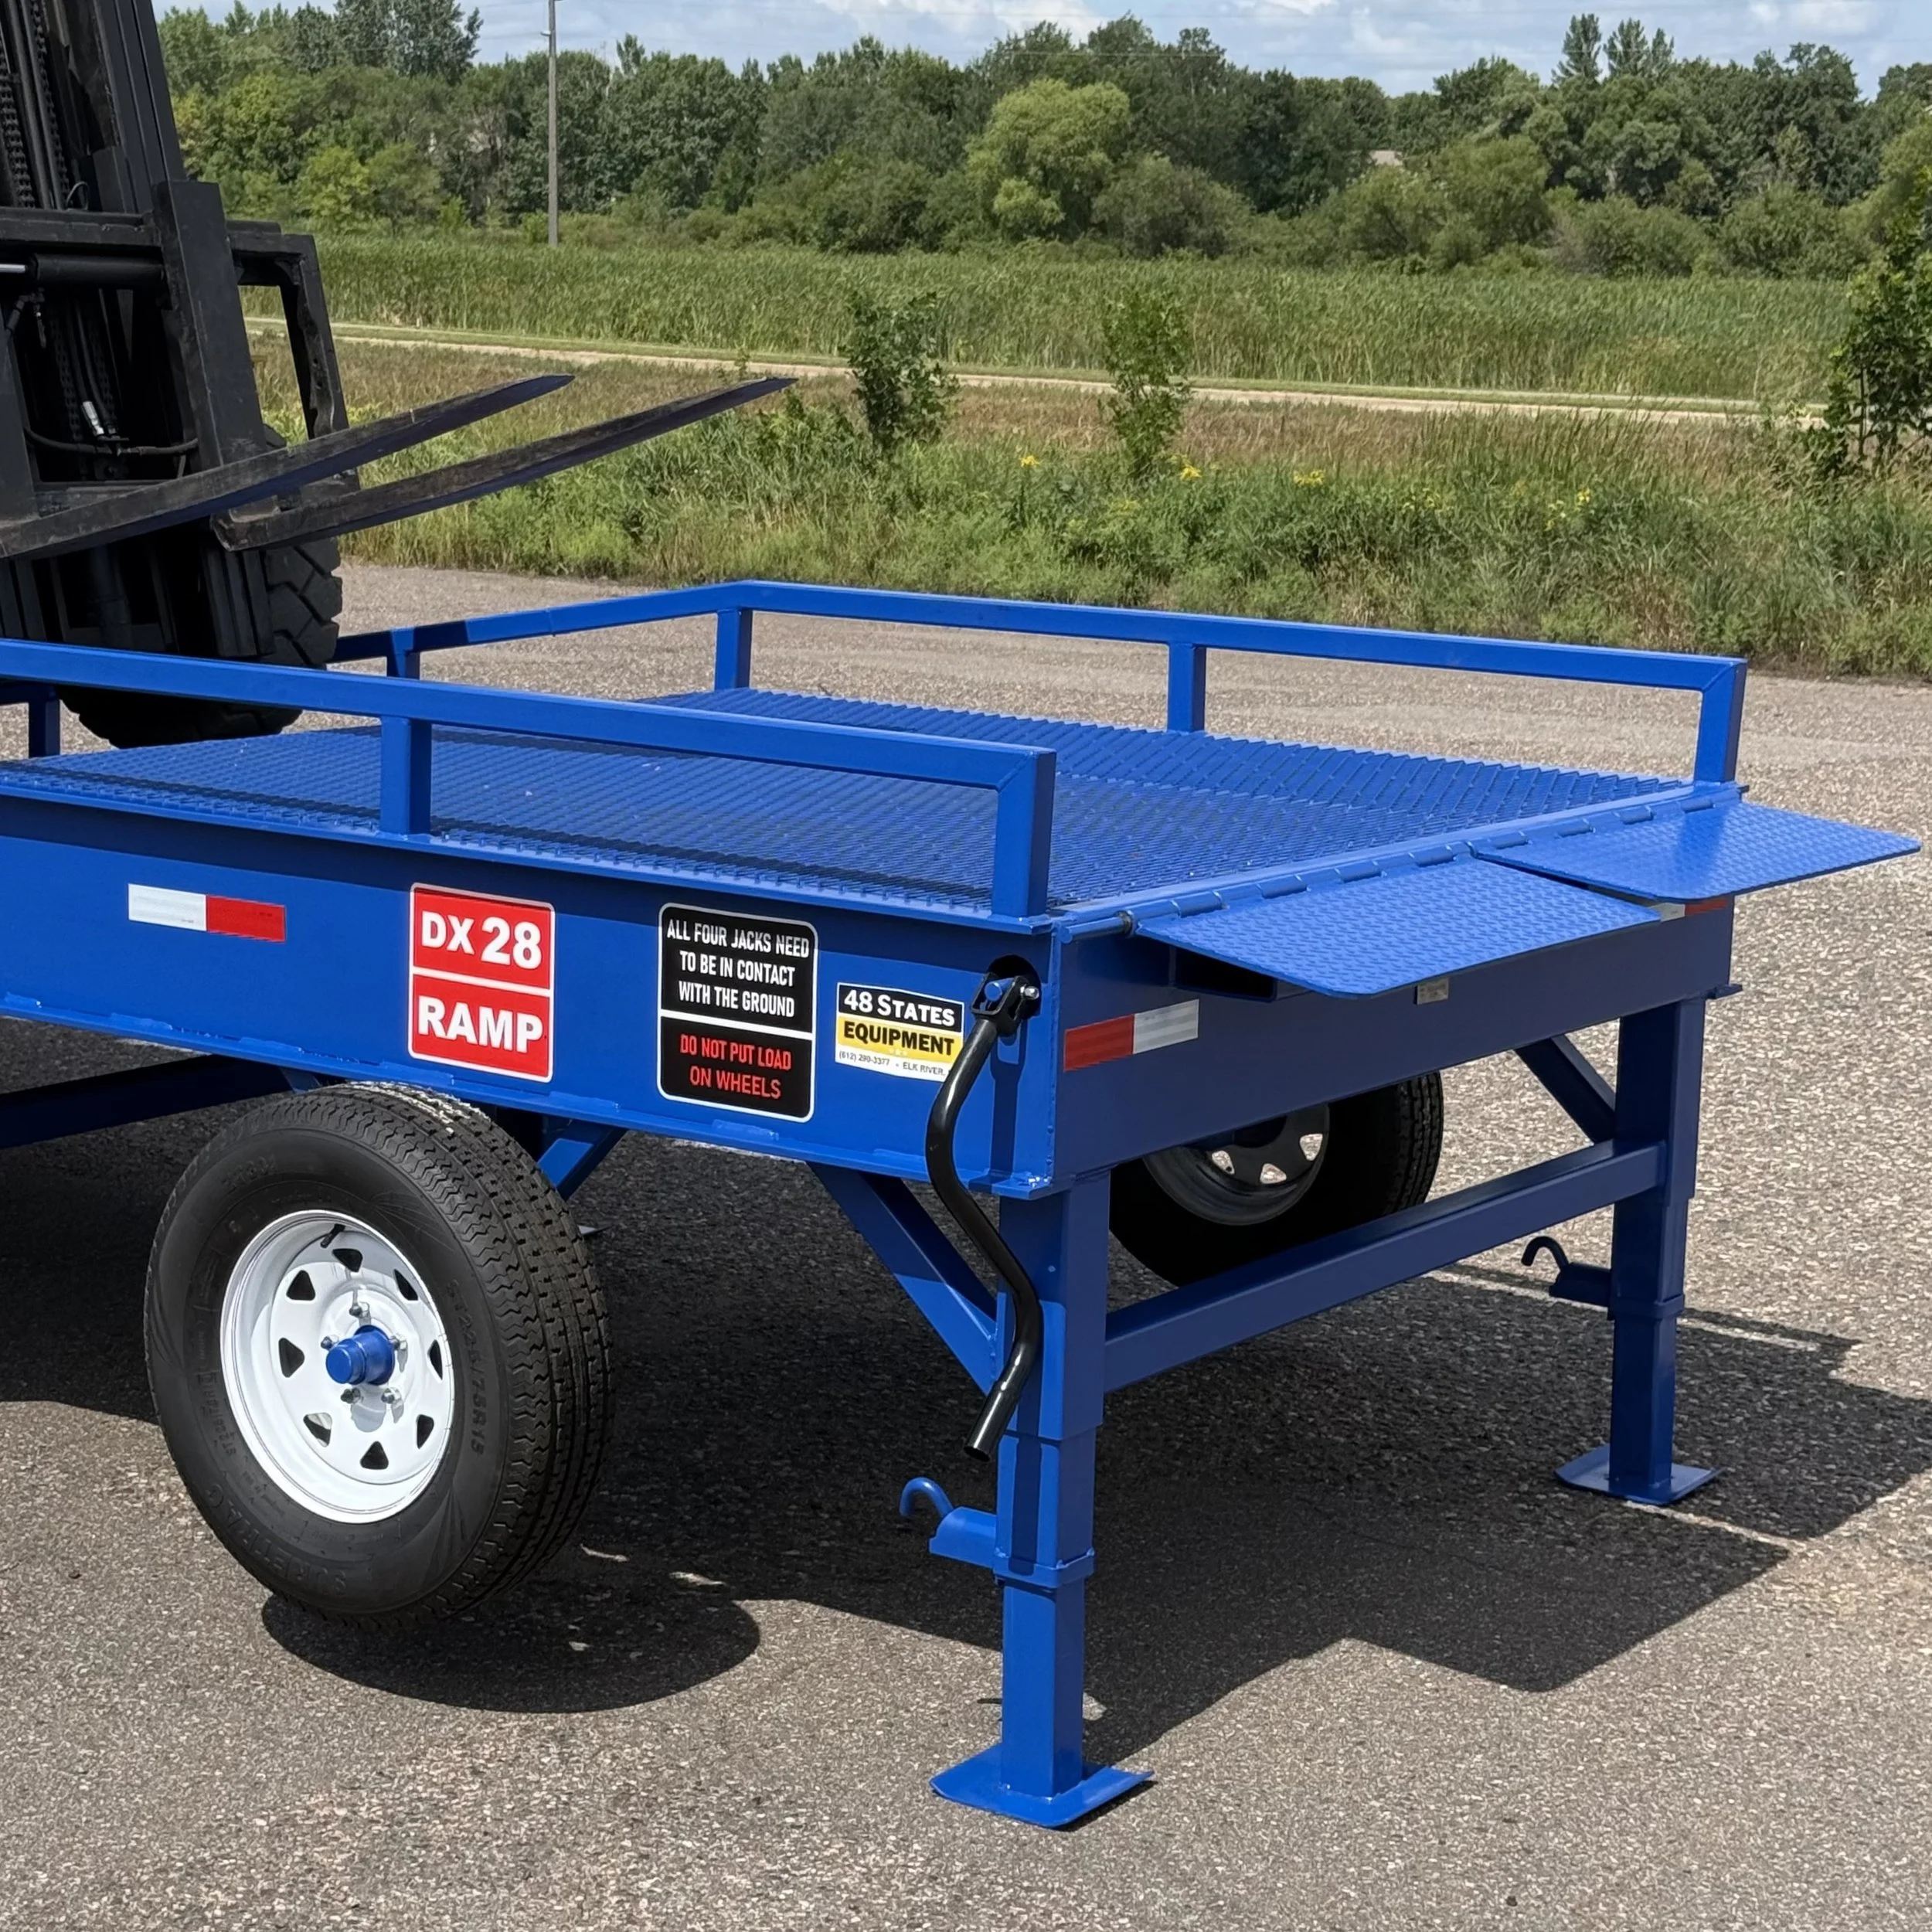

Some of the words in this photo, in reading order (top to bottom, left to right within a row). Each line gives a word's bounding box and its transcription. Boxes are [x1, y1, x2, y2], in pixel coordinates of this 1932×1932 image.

[421, 910, 475, 955] DX
[481, 917, 543, 969] 28
[667, 919, 690, 940] ALL
[694, 922, 727, 947] FOUR
[731, 928, 771, 953] JACKS
[775, 934, 809, 958] NEED
[679, 950, 696, 972] TO
[700, 953, 716, 975] BE
[719, 957, 733, 978] IN
[736, 960, 795, 987] CONTACT
[679, 980, 711, 1005] WITH
[714, 986, 739, 1009] THE
[742, 991, 795, 1018] GROUND
[844, 989, 873, 1013] 48
[877, 994, 955, 1026] STATES
[418, 995, 543, 1053] RAMP
[844, 1020, 954, 1056] EQUIPMENT
[680, 1033, 696, 1055] DO
[701, 1037, 727, 1061] NOT
[730, 1042, 755, 1065] PUT
[757, 1046, 791, 1070] LOAD
[839, 1051, 857, 1063] (612)
[903, 1062, 918, 1071] ELK
[689, 1066, 712, 1088] ON
[716, 1070, 781, 1099] WHEELS
